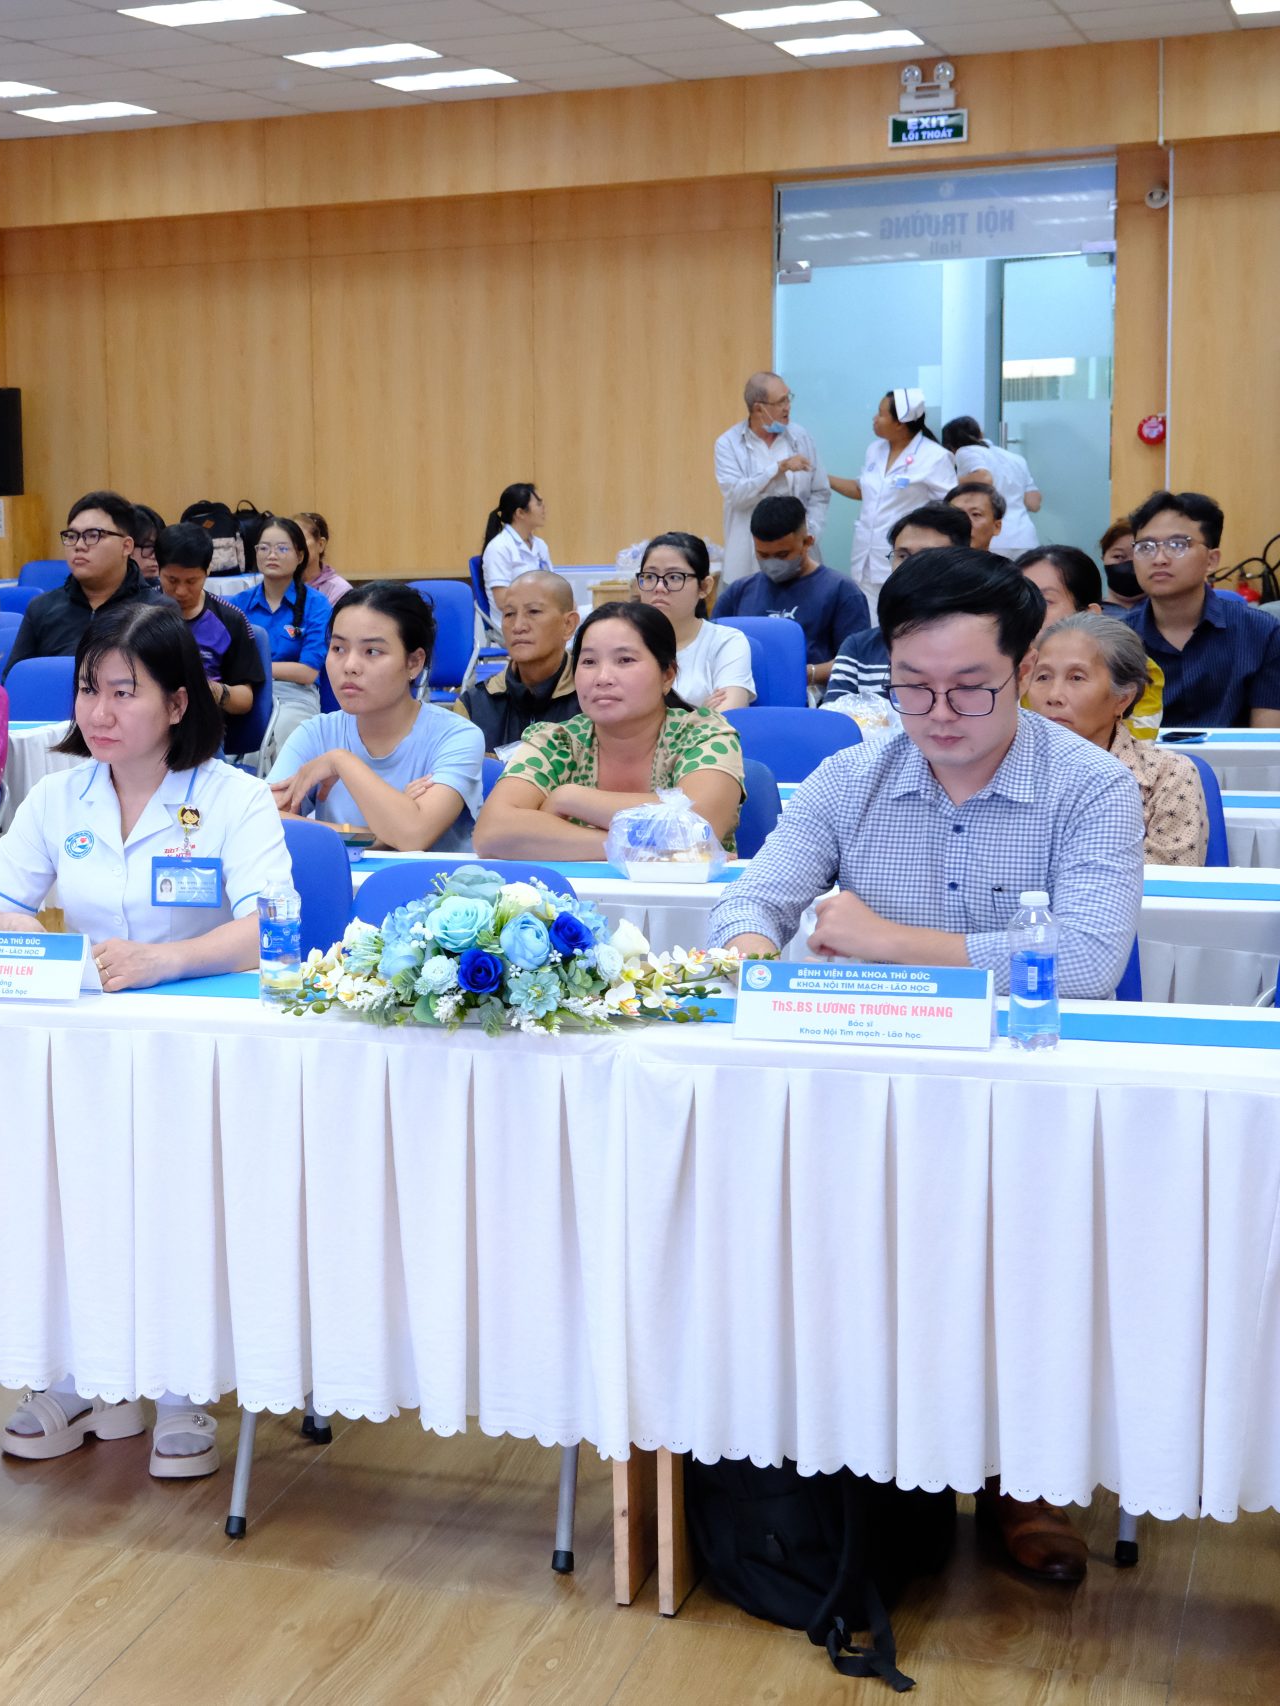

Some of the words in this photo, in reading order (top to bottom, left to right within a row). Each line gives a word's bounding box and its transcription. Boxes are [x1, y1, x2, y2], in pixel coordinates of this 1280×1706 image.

[907, 115, 949, 130] EXIT
[921, 127, 954, 140] THOÁT
[10, 935, 24, 945] THỦ
[25, 936, 41, 945] ĐỨC
[0, 965, 14, 977] THỊ
[15, 965, 34, 976] LEN
[797, 967, 821, 977] BỆNH
[823, 968, 843, 979] VIỆN
[845, 970, 859, 978] ĐA
[861, 971, 888, 979] KHOA
[890, 969, 908, 980] THỦ
[910, 970, 931, 980] ĐỨC
[823, 980, 839, 989] NỘI
[857, 983, 884, 992] MẠCH
[891, 982, 908, 991] LÃO
[910, 984, 930, 993] HỌC
[772, 1000, 813, 1013] ThS.BS
[816, 1001, 856, 1015] LƯƠNG
[911, 1006, 953, 1018] KHANG
[848, 1019, 864, 1028] Bác
[799, 1027, 822, 1036] Khoa
[824, 1027, 837, 1037] Nội
[840, 1029, 854, 1037] Tim
[856, 1029, 880, 1039] mạch
[887, 1030, 903, 1039] Lão
[905, 1031, 921, 1040] học
